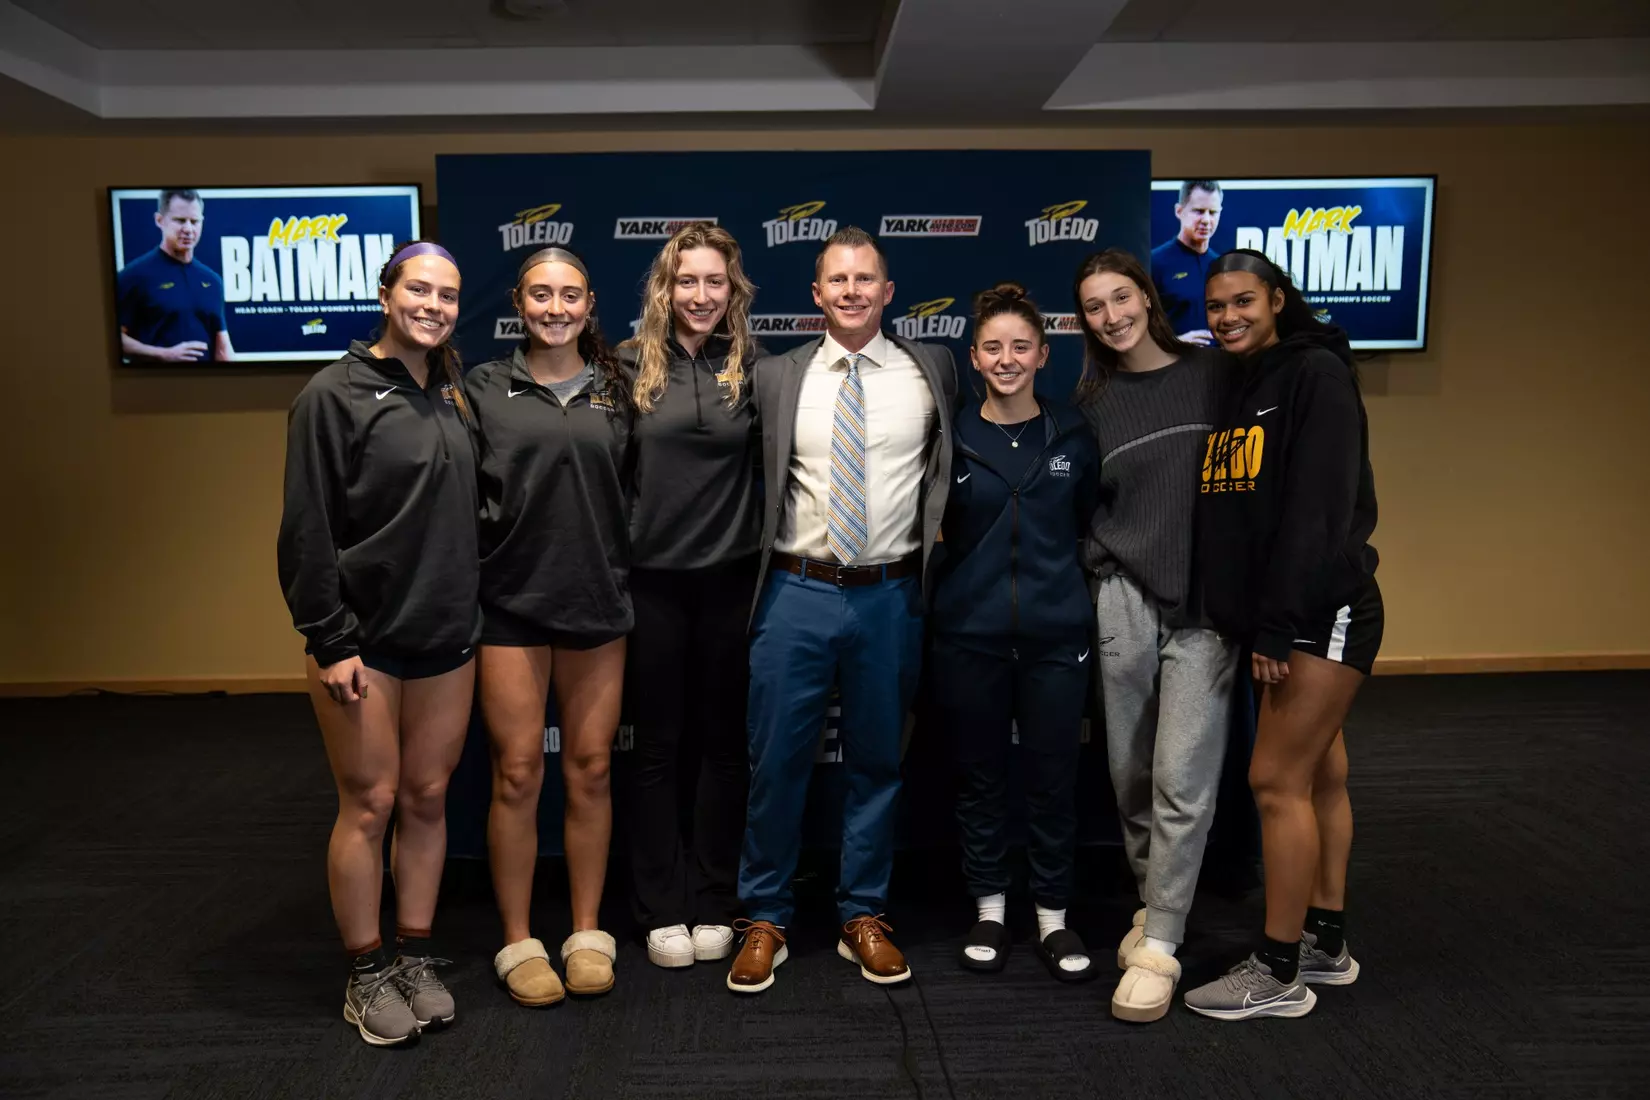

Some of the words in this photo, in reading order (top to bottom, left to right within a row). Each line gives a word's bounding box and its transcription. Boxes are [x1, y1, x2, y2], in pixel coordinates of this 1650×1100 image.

[268, 213, 348, 248] MARK
[620, 221, 665, 235] YARK
[884, 219, 930, 233] YARK
[1025, 216, 1099, 246] TOLEDO
[1283, 205, 1362, 239] MARK
[498, 221, 574, 251] TOLEDO
[762, 218, 838, 248] TOLEDO
[289, 305, 320, 313] TOLEDO
[356, 304, 384, 312] SOCCE
[1361, 295, 1391, 303] SOCCER
[751, 318, 796, 331] YARK
[892, 315, 967, 340] TOLEDO
[1201, 481, 1256, 493] OCCER
